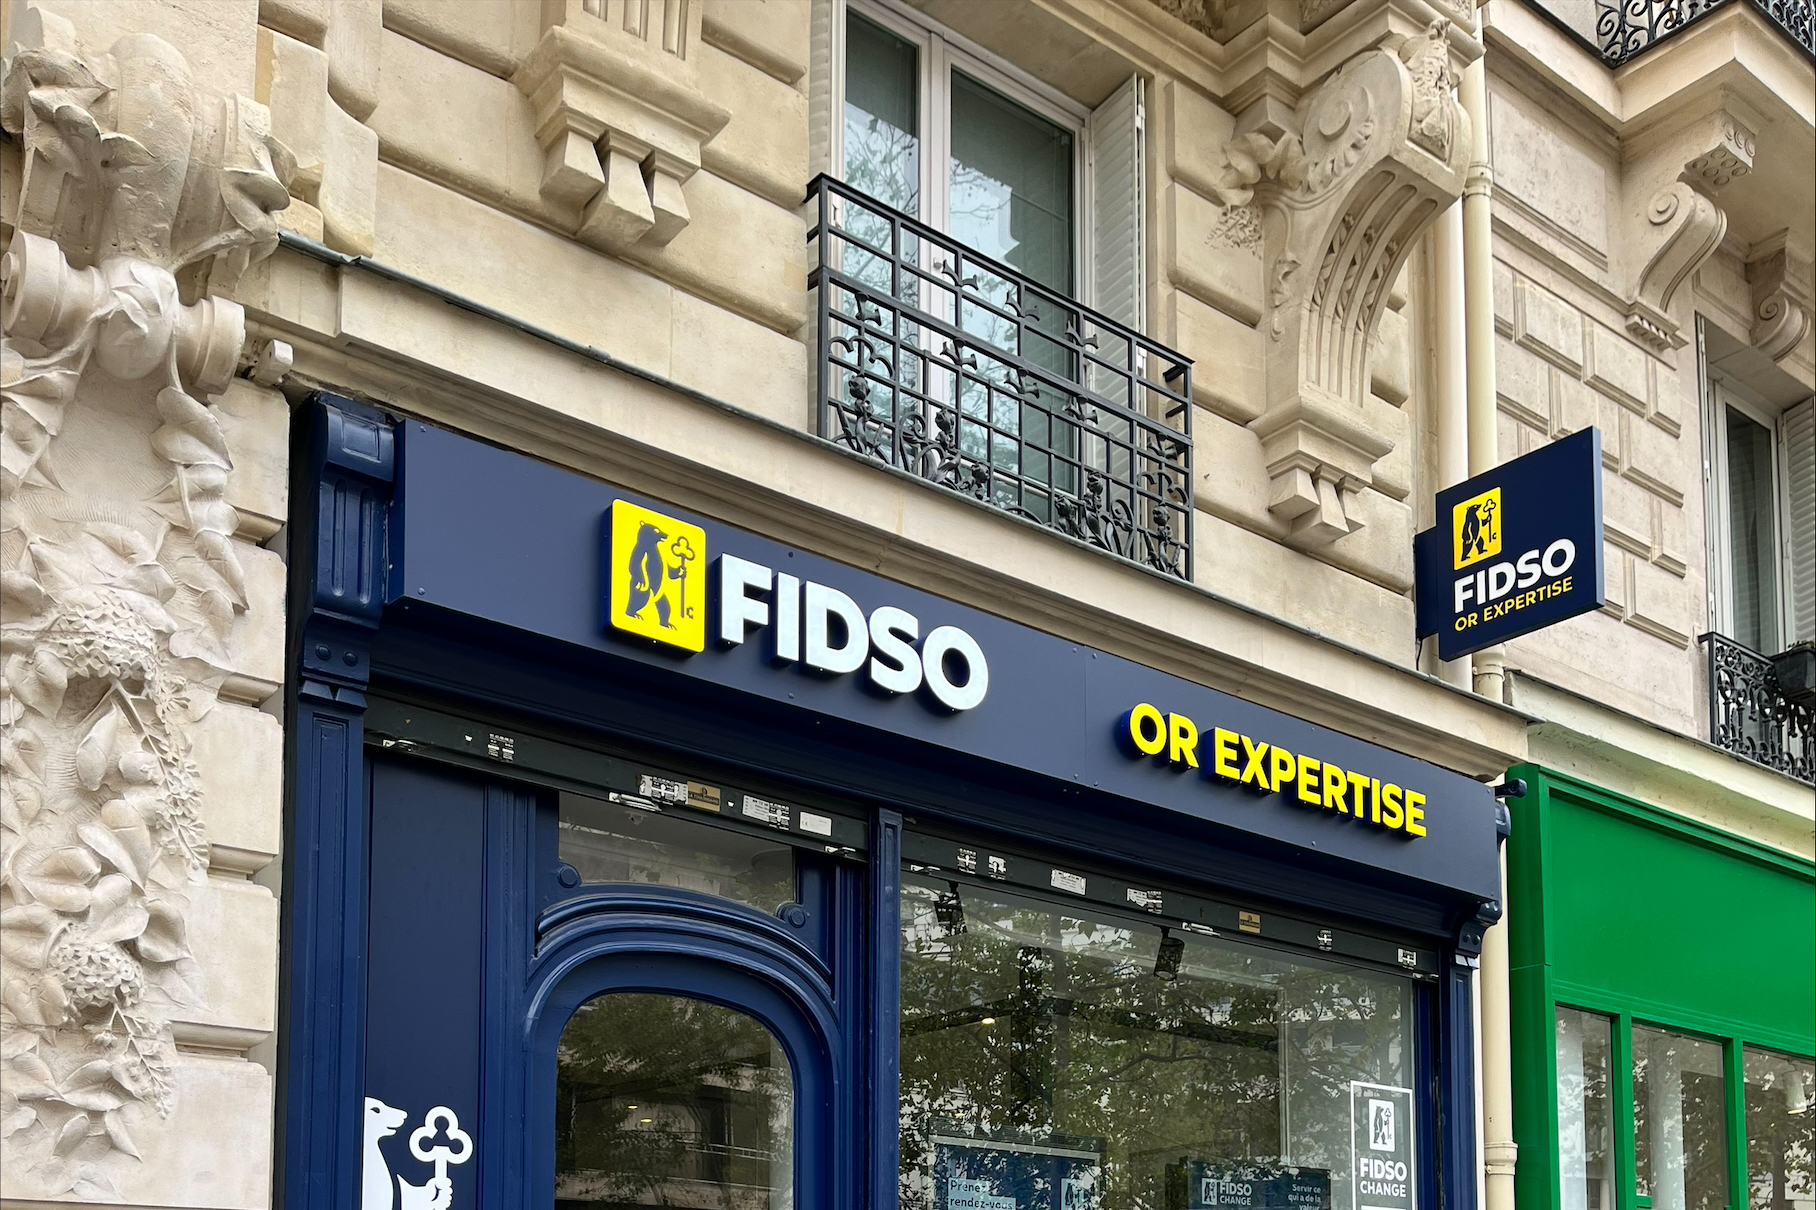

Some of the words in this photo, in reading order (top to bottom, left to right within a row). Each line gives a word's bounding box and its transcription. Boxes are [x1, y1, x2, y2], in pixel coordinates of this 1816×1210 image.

[1454, 538, 1576, 613] FIDSO
[1455, 613, 1478, 632] OR
[1483, 576, 1573, 622] EXPERTISE
[721, 553, 989, 711] FIDSO
[1129, 702, 1199, 769] OR
[1213, 727, 1427, 837] EXPERTISE
[1360, 1157, 1407, 1181] FIDSO
[950, 1180, 986, 1193] Prenez
[1220, 1182, 1252, 1196] FIDSO
[1292, 1184, 1313, 1193] Servir
[1360, 1181, 1407, 1198] CHANGE
[950, 1197, 1013, 1210] rendez-vous
[1220, 1195, 1252, 1206] CHANGE
[1288, 1194, 1299, 1202] qui
[1305, 1194, 1314, 1202] de
[1315, 1195, 1321, 1203] la
